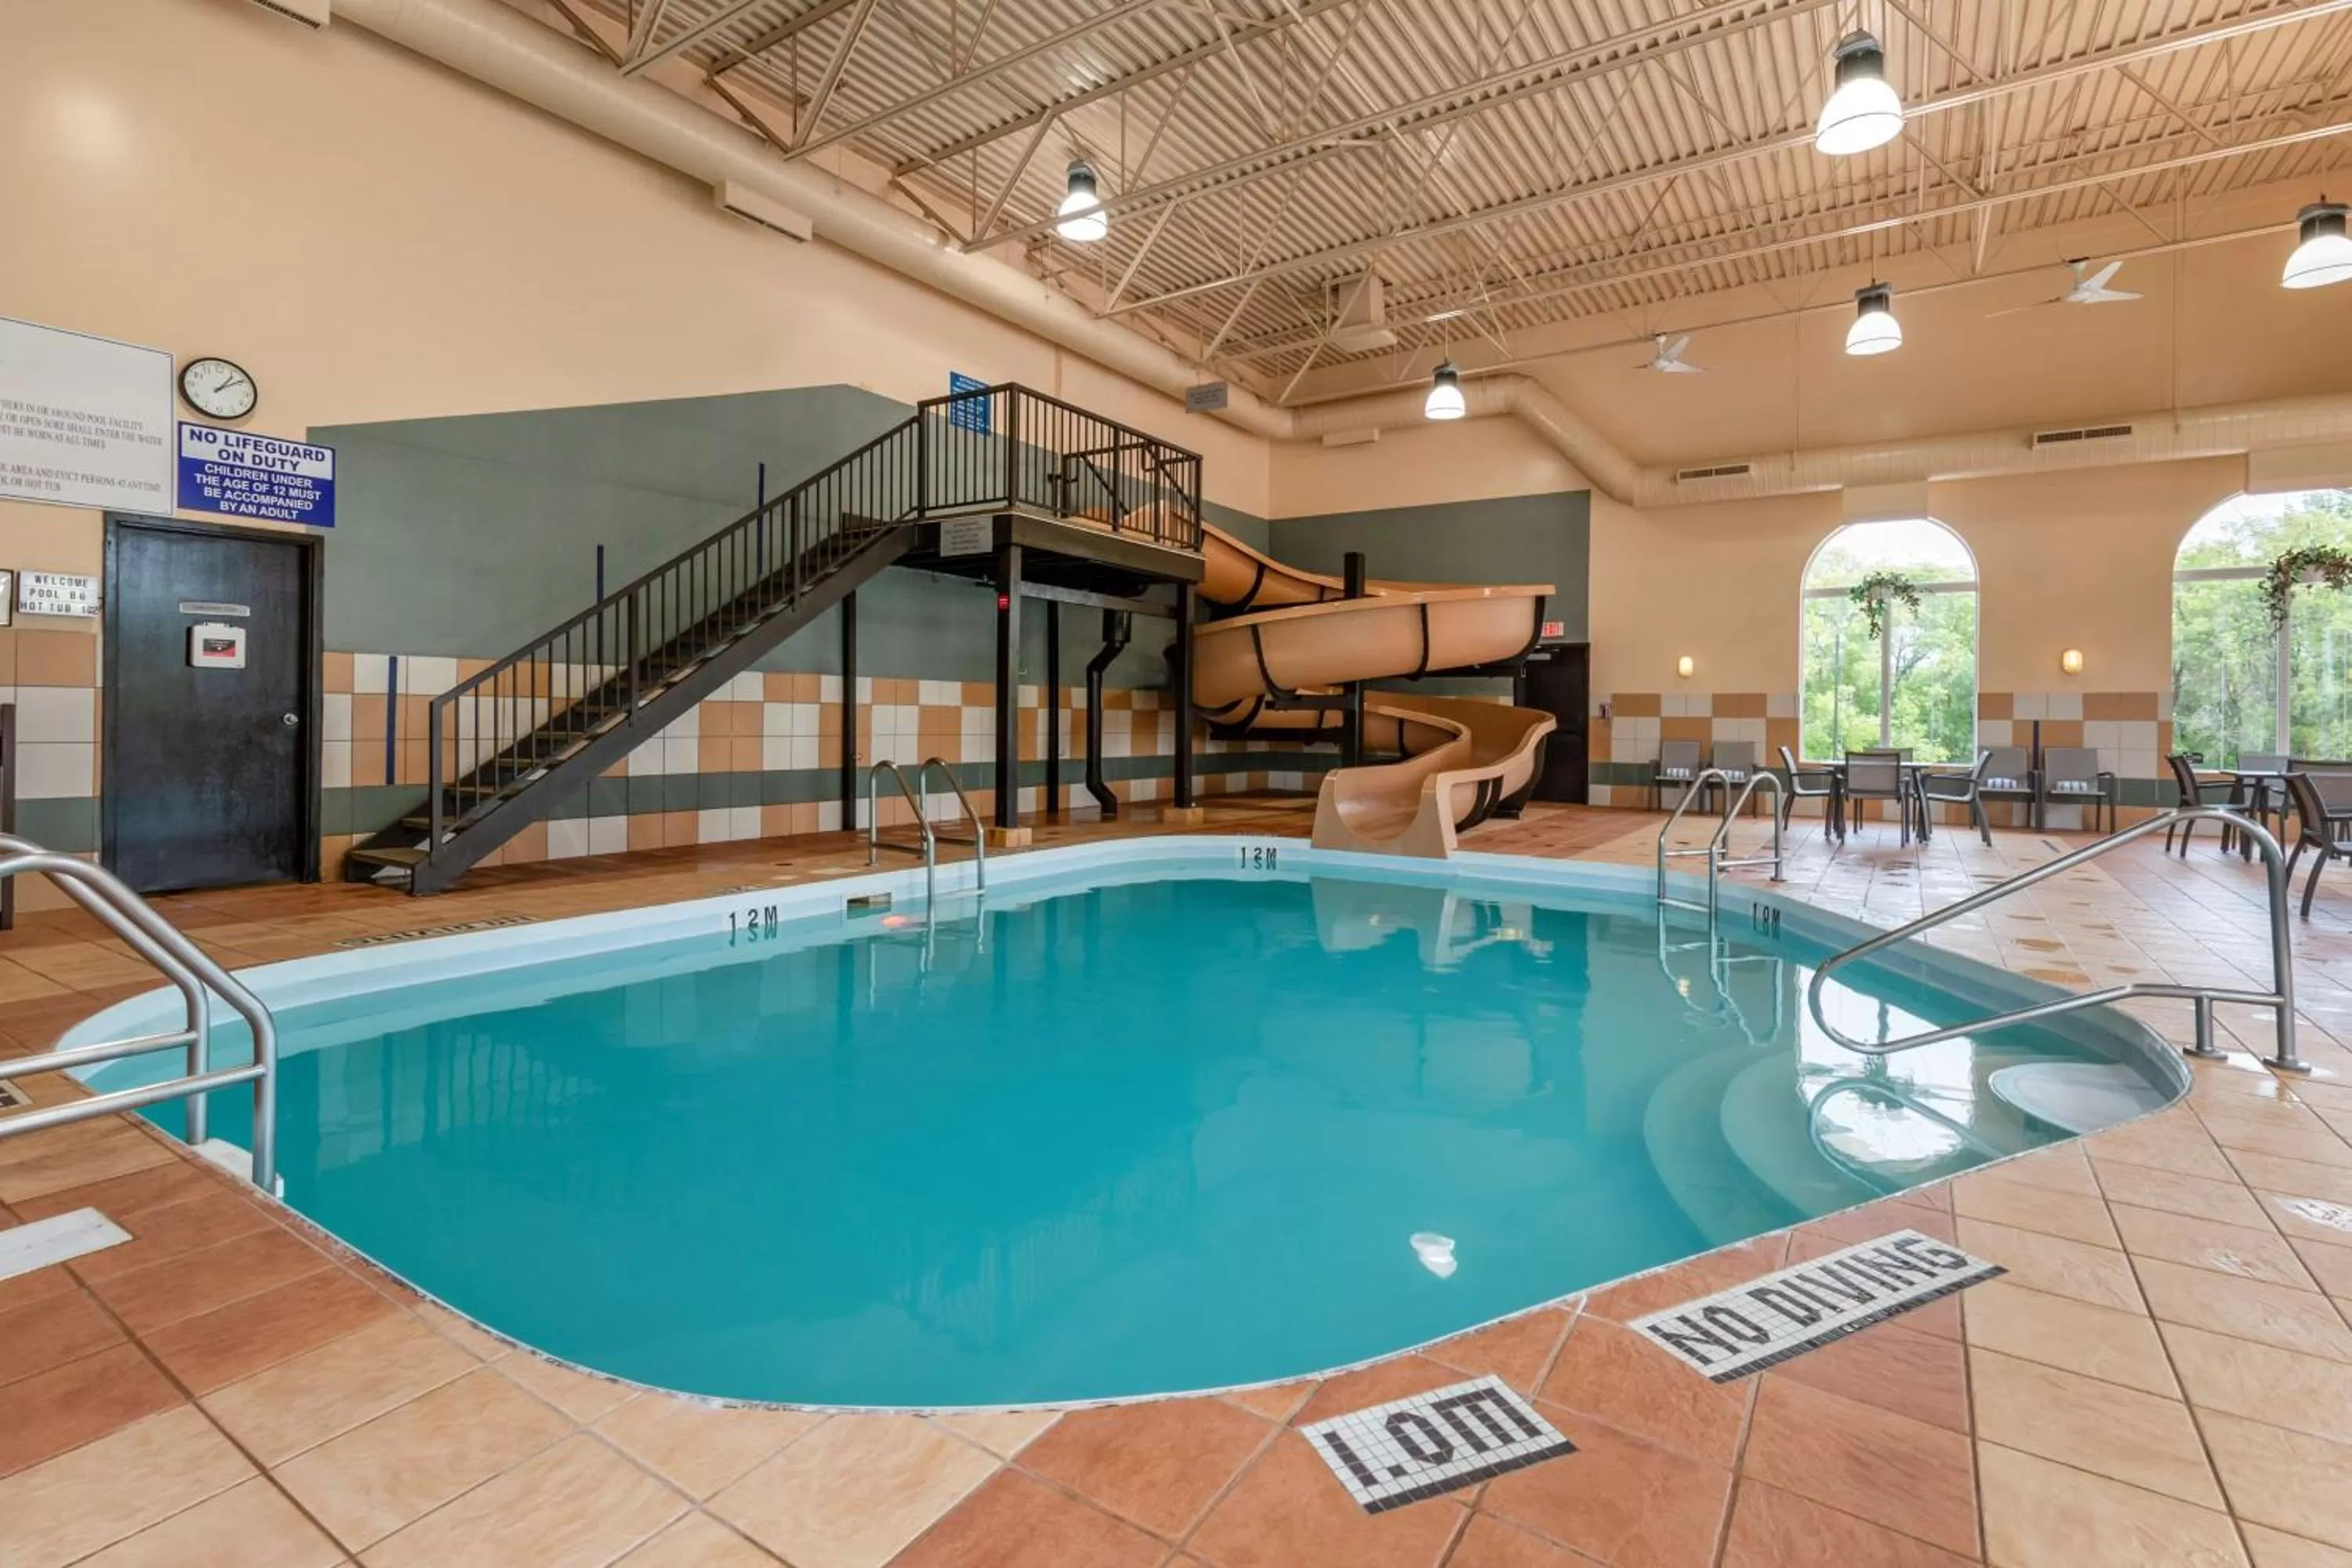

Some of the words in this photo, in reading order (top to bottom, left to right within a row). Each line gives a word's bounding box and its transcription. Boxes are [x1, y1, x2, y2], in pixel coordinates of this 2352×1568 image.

[190, 429, 217, 444] NO
[224, 435, 325, 462] LIFEGUARD
[218, 448, 245, 463] ON
[252, 454, 300, 471] DUTY
[194, 473, 220, 485] THE
[223, 478, 249, 492] AGE
[253, 482, 270, 493] OF
[272, 485, 287, 496] 12
[289, 488, 322, 501] MUST
[205, 463, 268, 482] CHILDREN
[270, 474, 313, 488] UNDER
[204, 487, 222, 498] BE
[223, 490, 313, 510] ACCOMPANIED
[220, 501, 239, 512] BY
[239, 504, 257, 514] AN
[260, 506, 299, 520] ADULT
[34, 575, 88, 588] WELCOME
[29, 588, 60, 599] POOL
[20, 601, 43, 612] HOT
[49, 603, 71, 613] TUB
[1647, 1305, 1771, 1366] NO
[1747, 1237, 1969, 1328] DIVING
